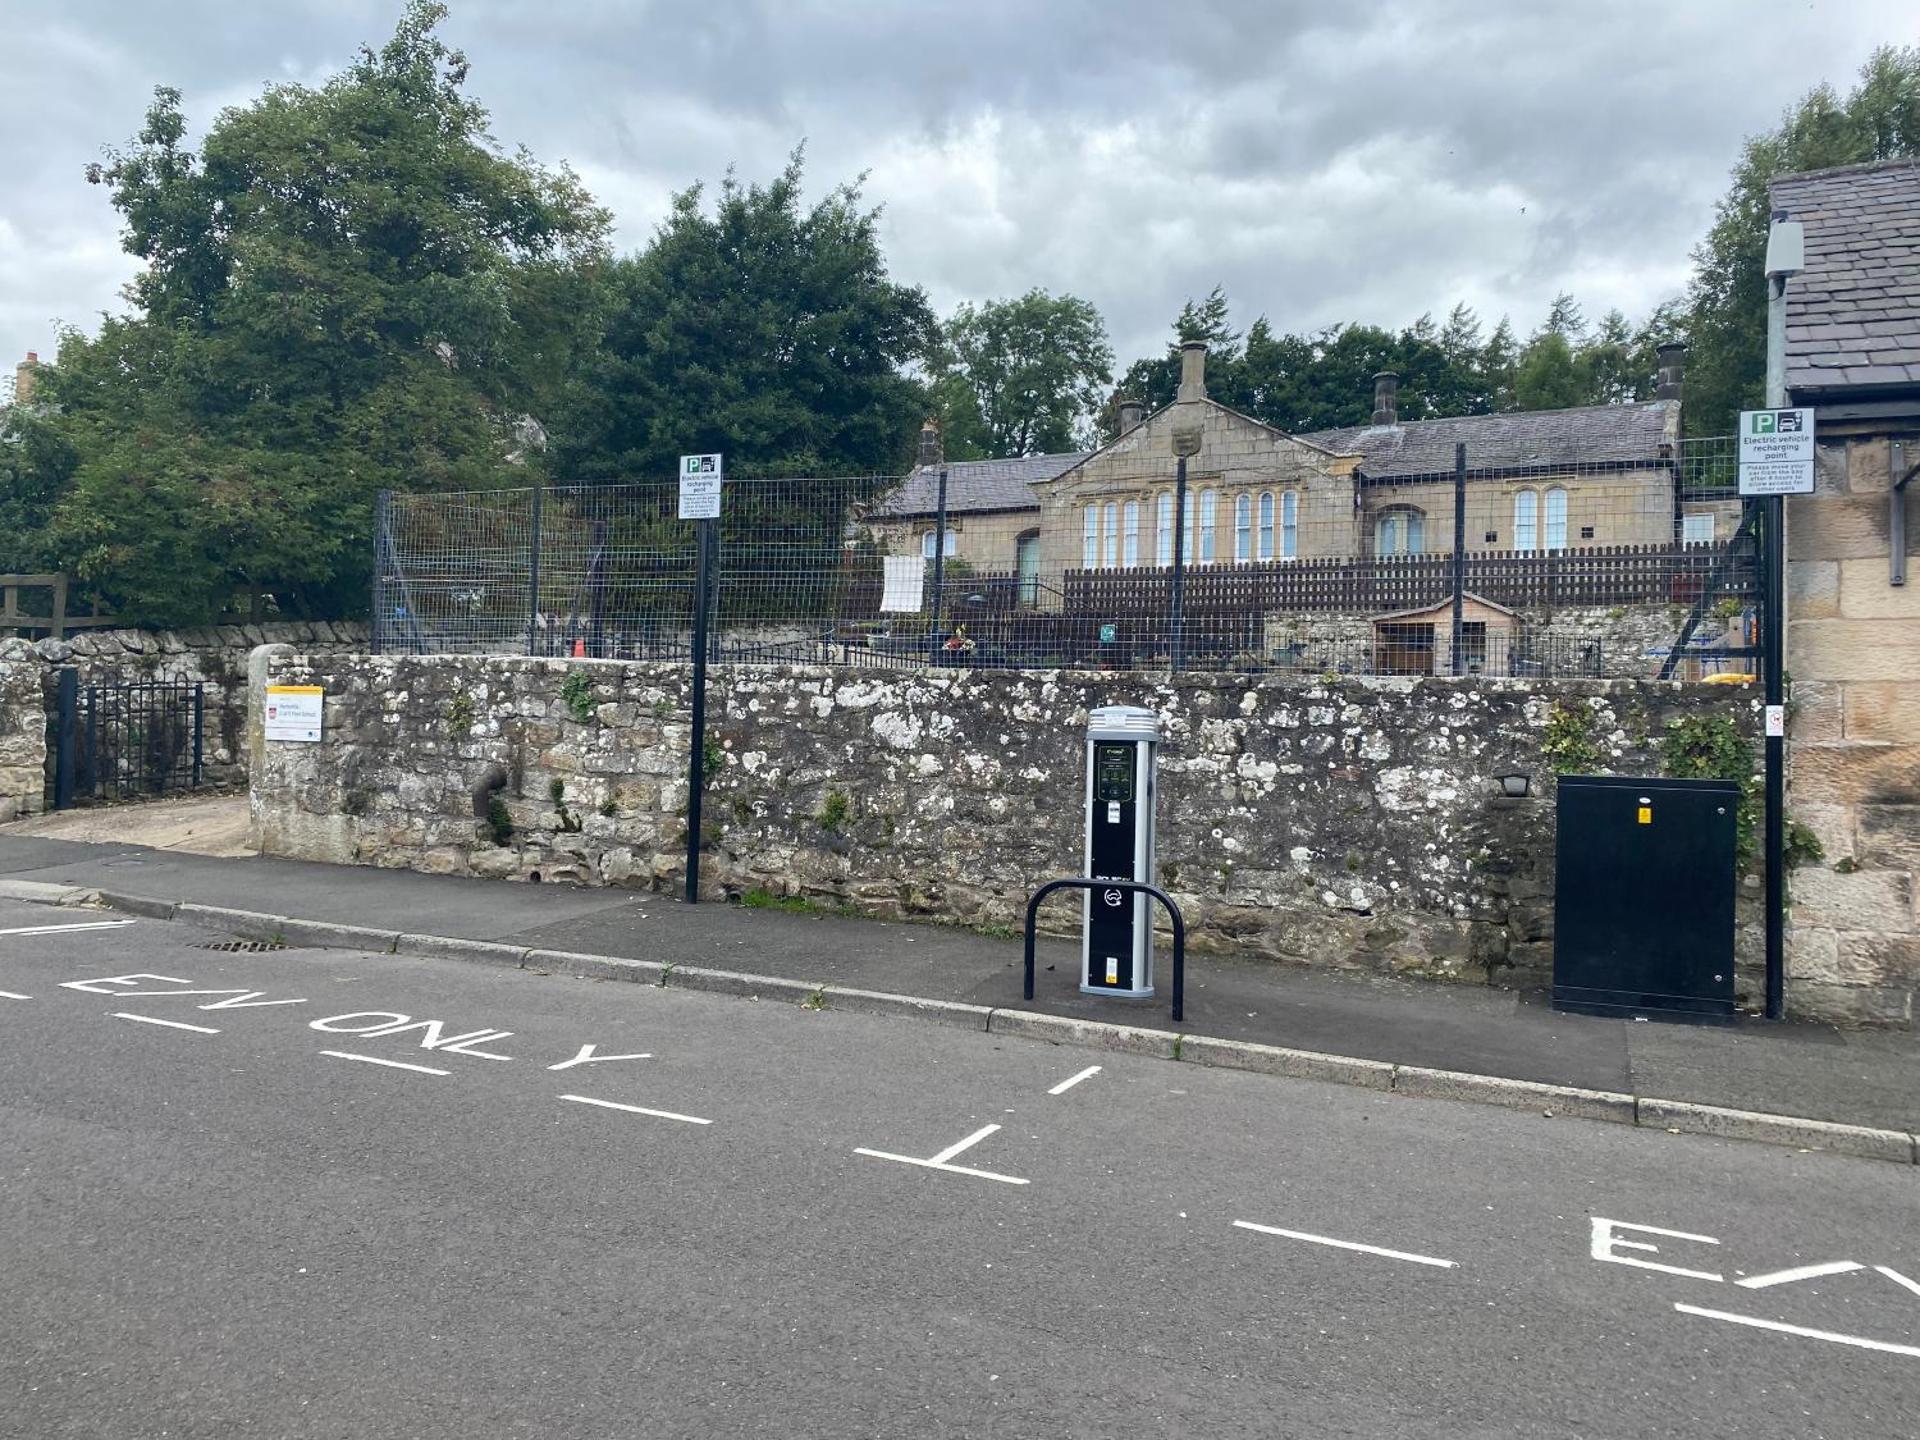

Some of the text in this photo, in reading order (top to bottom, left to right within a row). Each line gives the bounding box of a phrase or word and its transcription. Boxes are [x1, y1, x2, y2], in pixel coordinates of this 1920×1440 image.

[1757, 414, 1773, 432] P
[1744, 435, 1809, 444] Electric vehicle
[1753, 444, 1799, 452] recharging
[690, 459, 699, 472] P
[308, 1011, 652, 1071] ONLY
